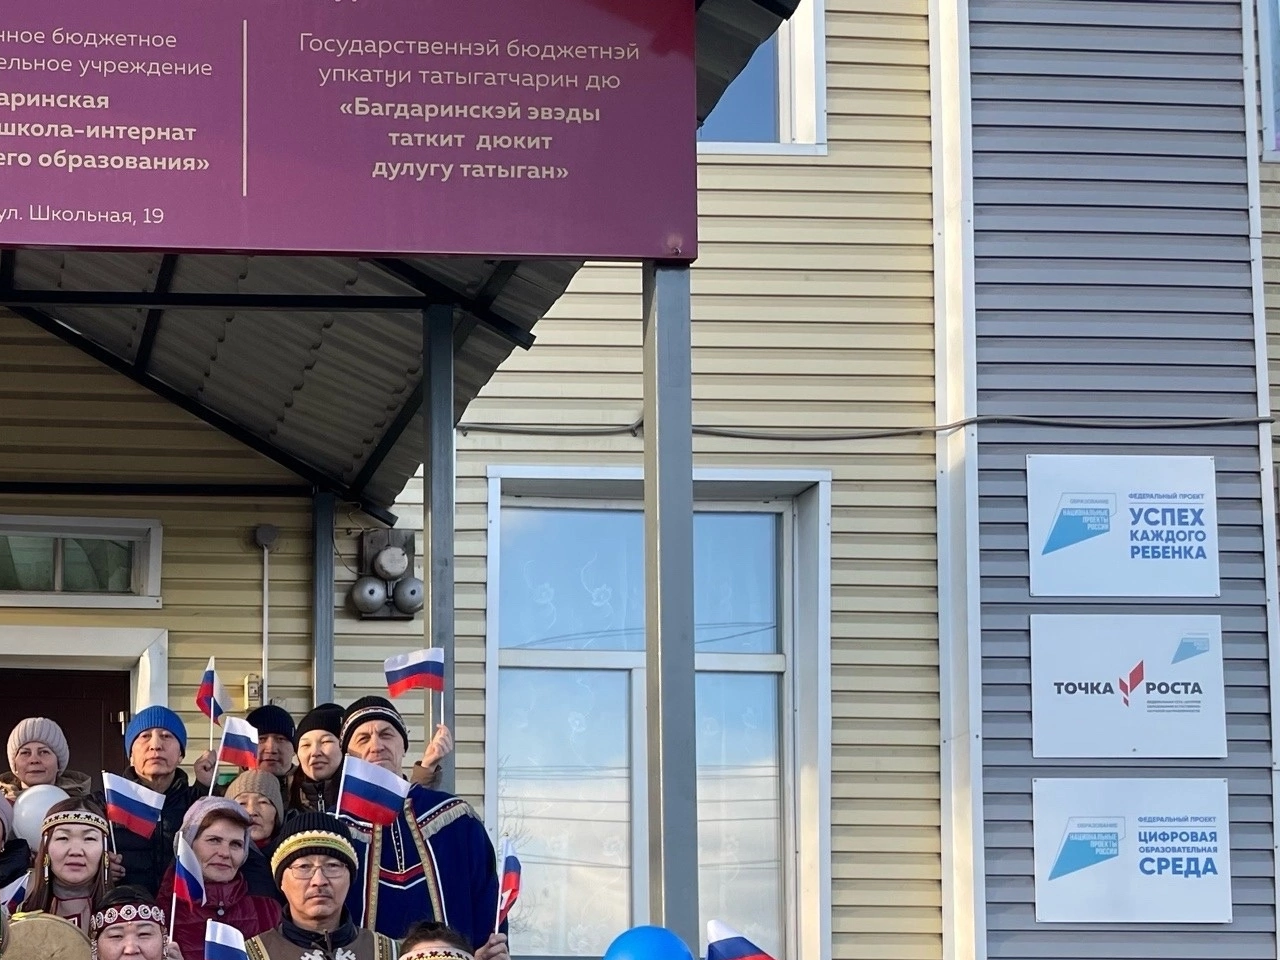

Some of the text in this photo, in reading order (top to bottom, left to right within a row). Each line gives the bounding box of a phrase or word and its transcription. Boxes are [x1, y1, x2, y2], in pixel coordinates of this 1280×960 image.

[51, 26, 177, 49] бюджетное
[300, 32, 640, 61] Государственнэй бюджетнэй
[78, 59, 213, 78] учреждение
[418, 70, 578, 92] татыгатчарин
[585, 74, 621, 92] дю
[339, 96, 600, 124] «Багдаринскэй эвэды
[387, 132, 553, 152] таткит дюкит
[38, 149, 210, 173] образования»
[371, 161, 569, 183] дулугу татыган»
[29, 204, 137, 227] Школьная,
[143, 207, 165, 224] 19
[1128, 507, 1205, 526] УСПЕХ
[1129, 529, 1207, 543] КАЖДОГО
[1130, 545, 1207, 559] РЕБЕНКА
[1053, 681, 1203, 695] ТОЧКА РОСТА
[1137, 815, 1189, 823] ФЕДЕРАЛЬНЫЙ
[1138, 831, 1218, 844] ЦИФРОВАЯ
[1138, 846, 1218, 854] ОБРАЗОВАТЕЛЬНАЯ
[1139, 857, 1219, 878] СРЕДА
